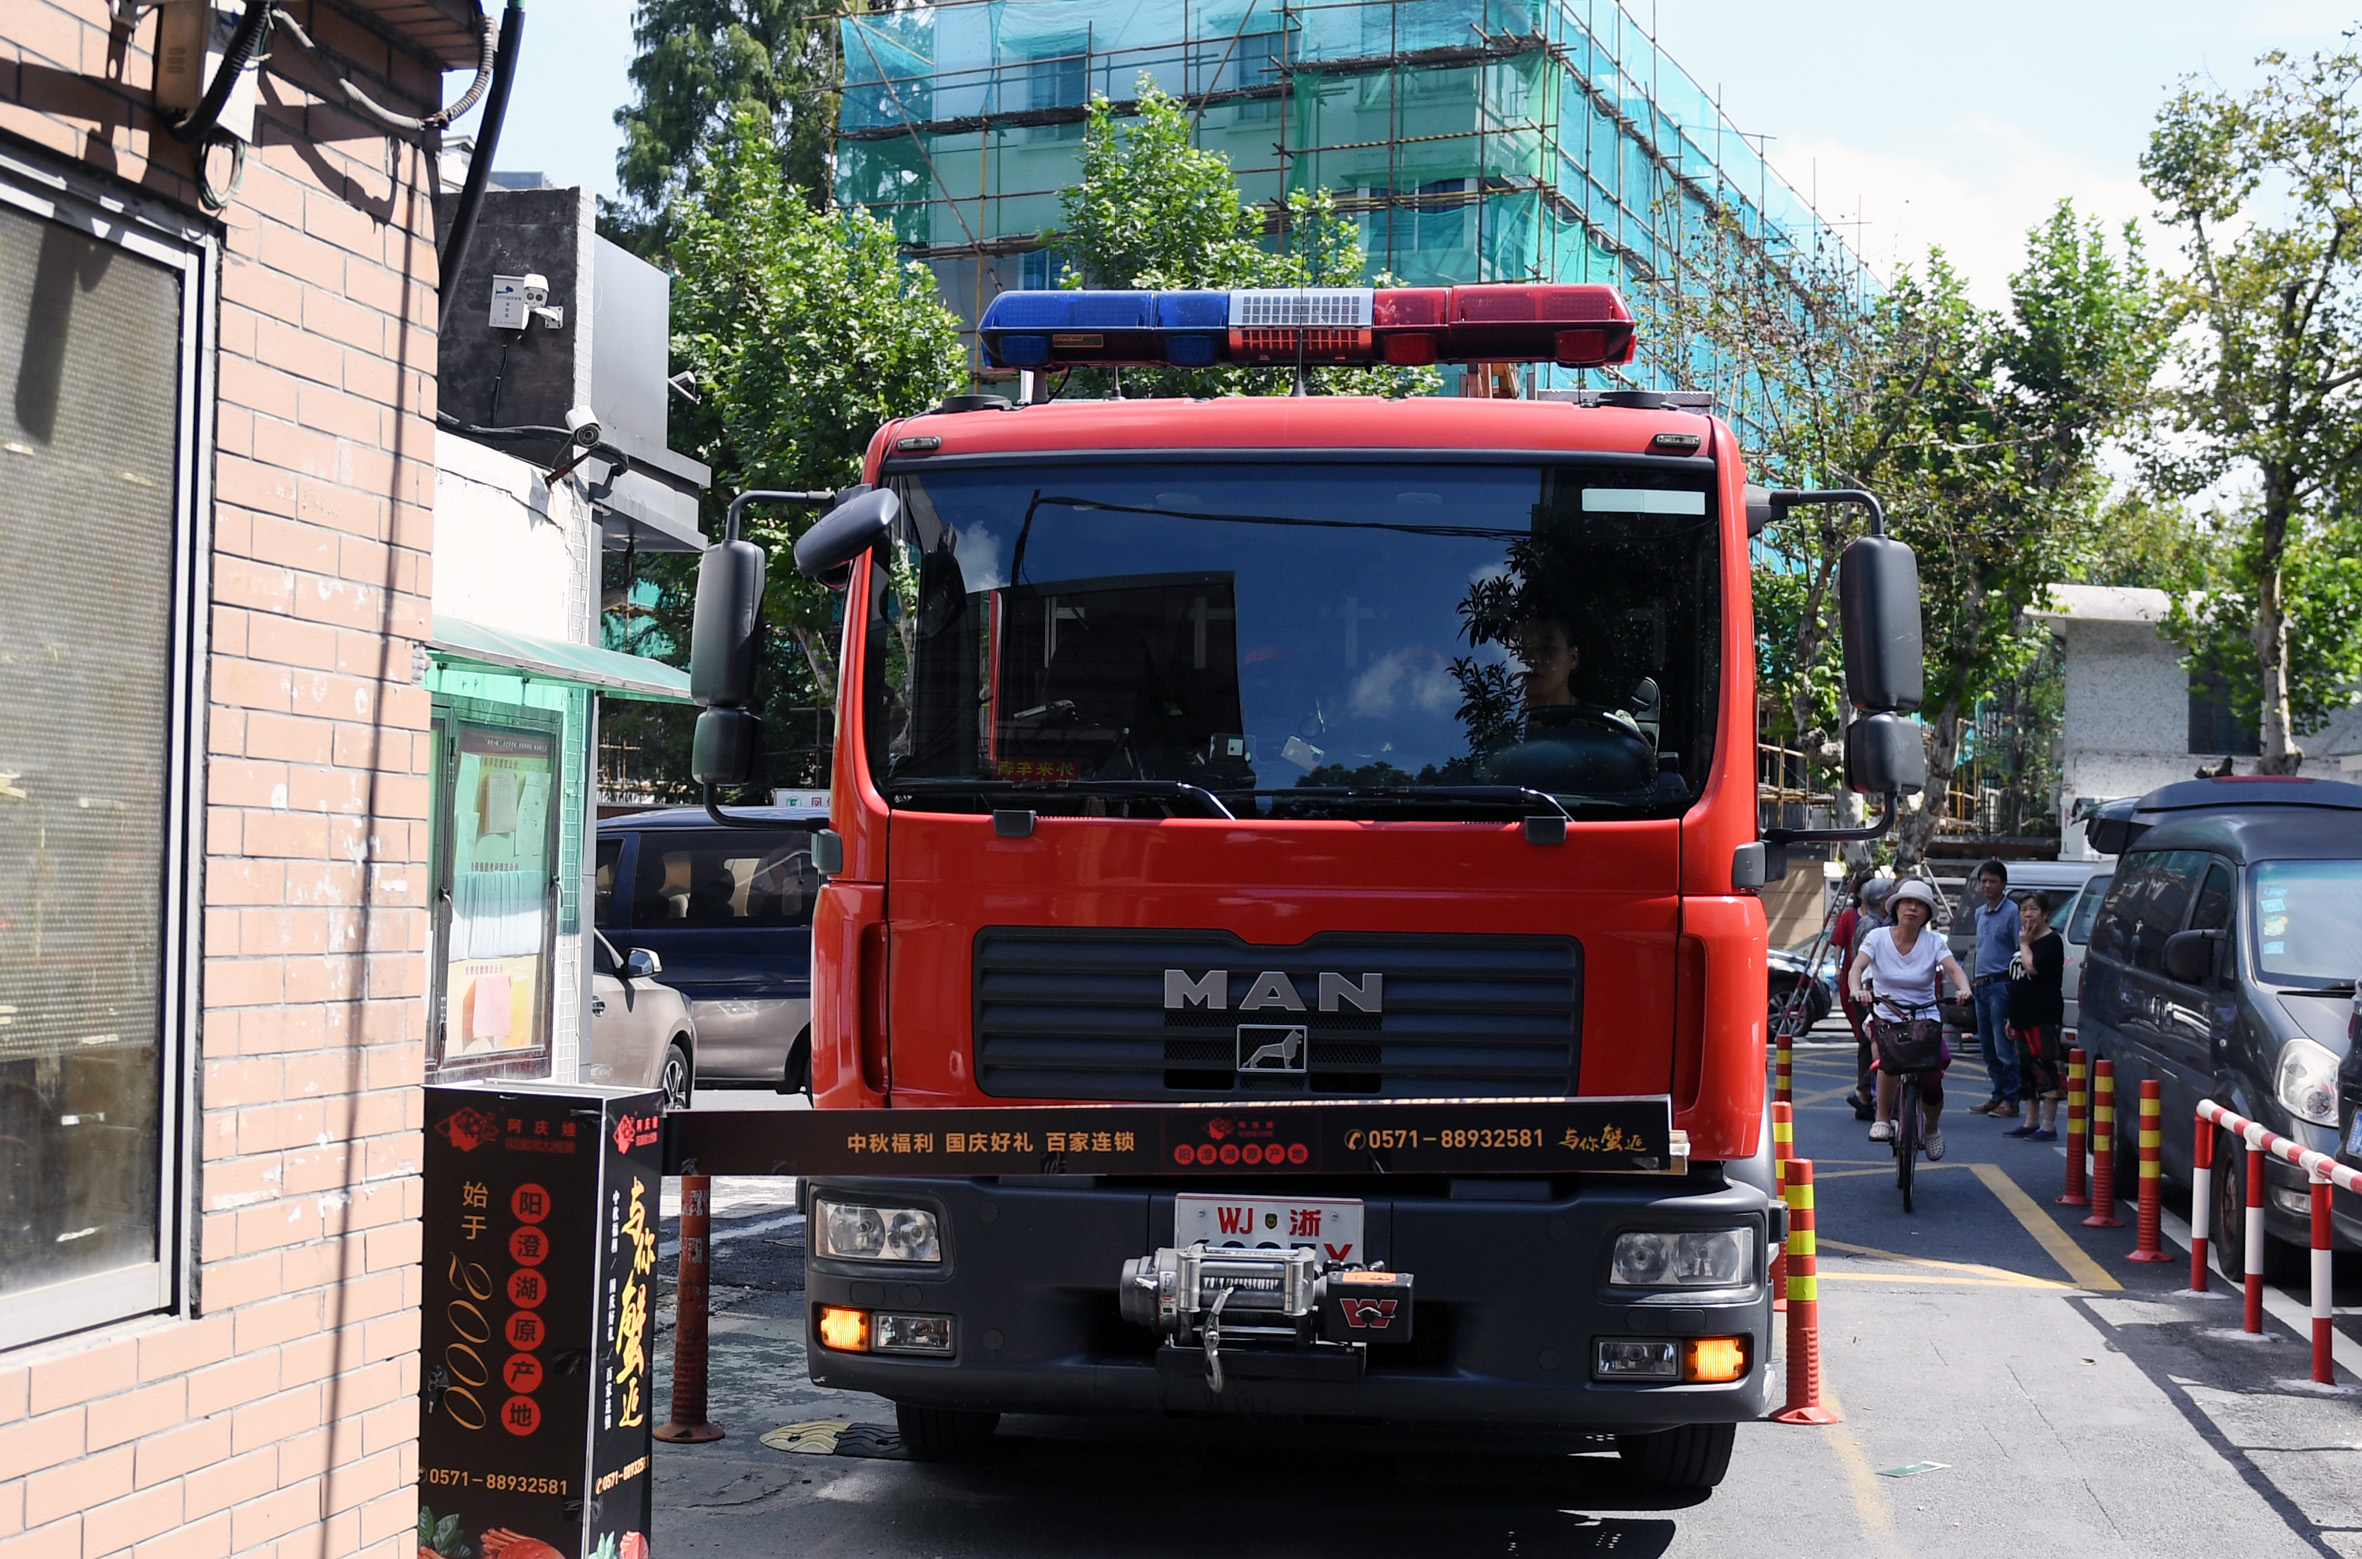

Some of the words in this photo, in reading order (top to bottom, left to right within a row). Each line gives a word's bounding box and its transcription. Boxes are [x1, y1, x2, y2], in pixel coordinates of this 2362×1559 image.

[1164, 968, 1382, 1012] MAN
[846, 1131, 934, 1154] 中秋福利
[945, 1131, 1034, 1154] 国庆好礼
[1046, 1130, 1135, 1153] 百家连锁
[1368, 1128, 1543, 1149] 0571-88932581
[462, 1181, 488, 1241] 始于
[1217, 1206, 1254, 1235] WJ
[1289, 1208, 1321, 1237] 浙
[507, 1190, 544, 1427] 阳澄湖原产地
[443, 1251, 493, 1431] 2000
[429, 1468, 568, 1495] 0571-88932581
